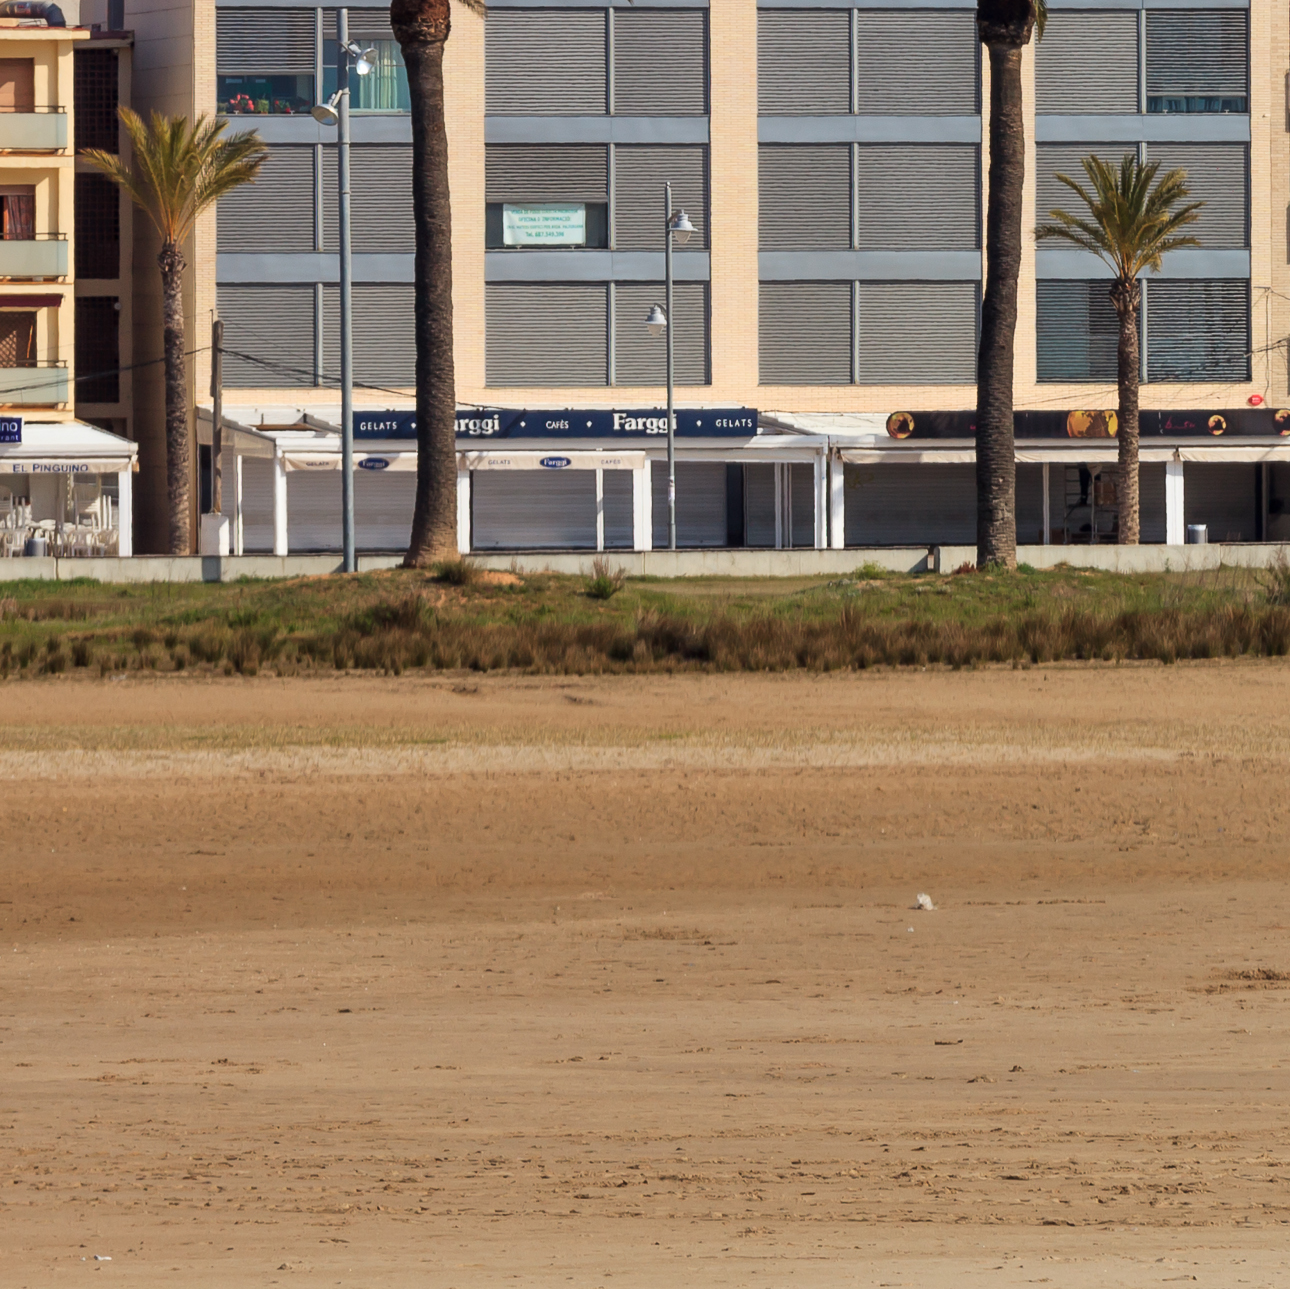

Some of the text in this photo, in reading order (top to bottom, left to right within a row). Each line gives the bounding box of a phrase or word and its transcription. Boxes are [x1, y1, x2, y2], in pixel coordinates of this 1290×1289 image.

[0, 421, 18, 432] no
[360, 421, 398, 431] GELATS
[454, 414, 500, 435] arggi
[612, 412, 677, 434] Farggi
[715, 418, 753, 428] GELATS
[12, 463, 89, 473] EL PINGUINO
